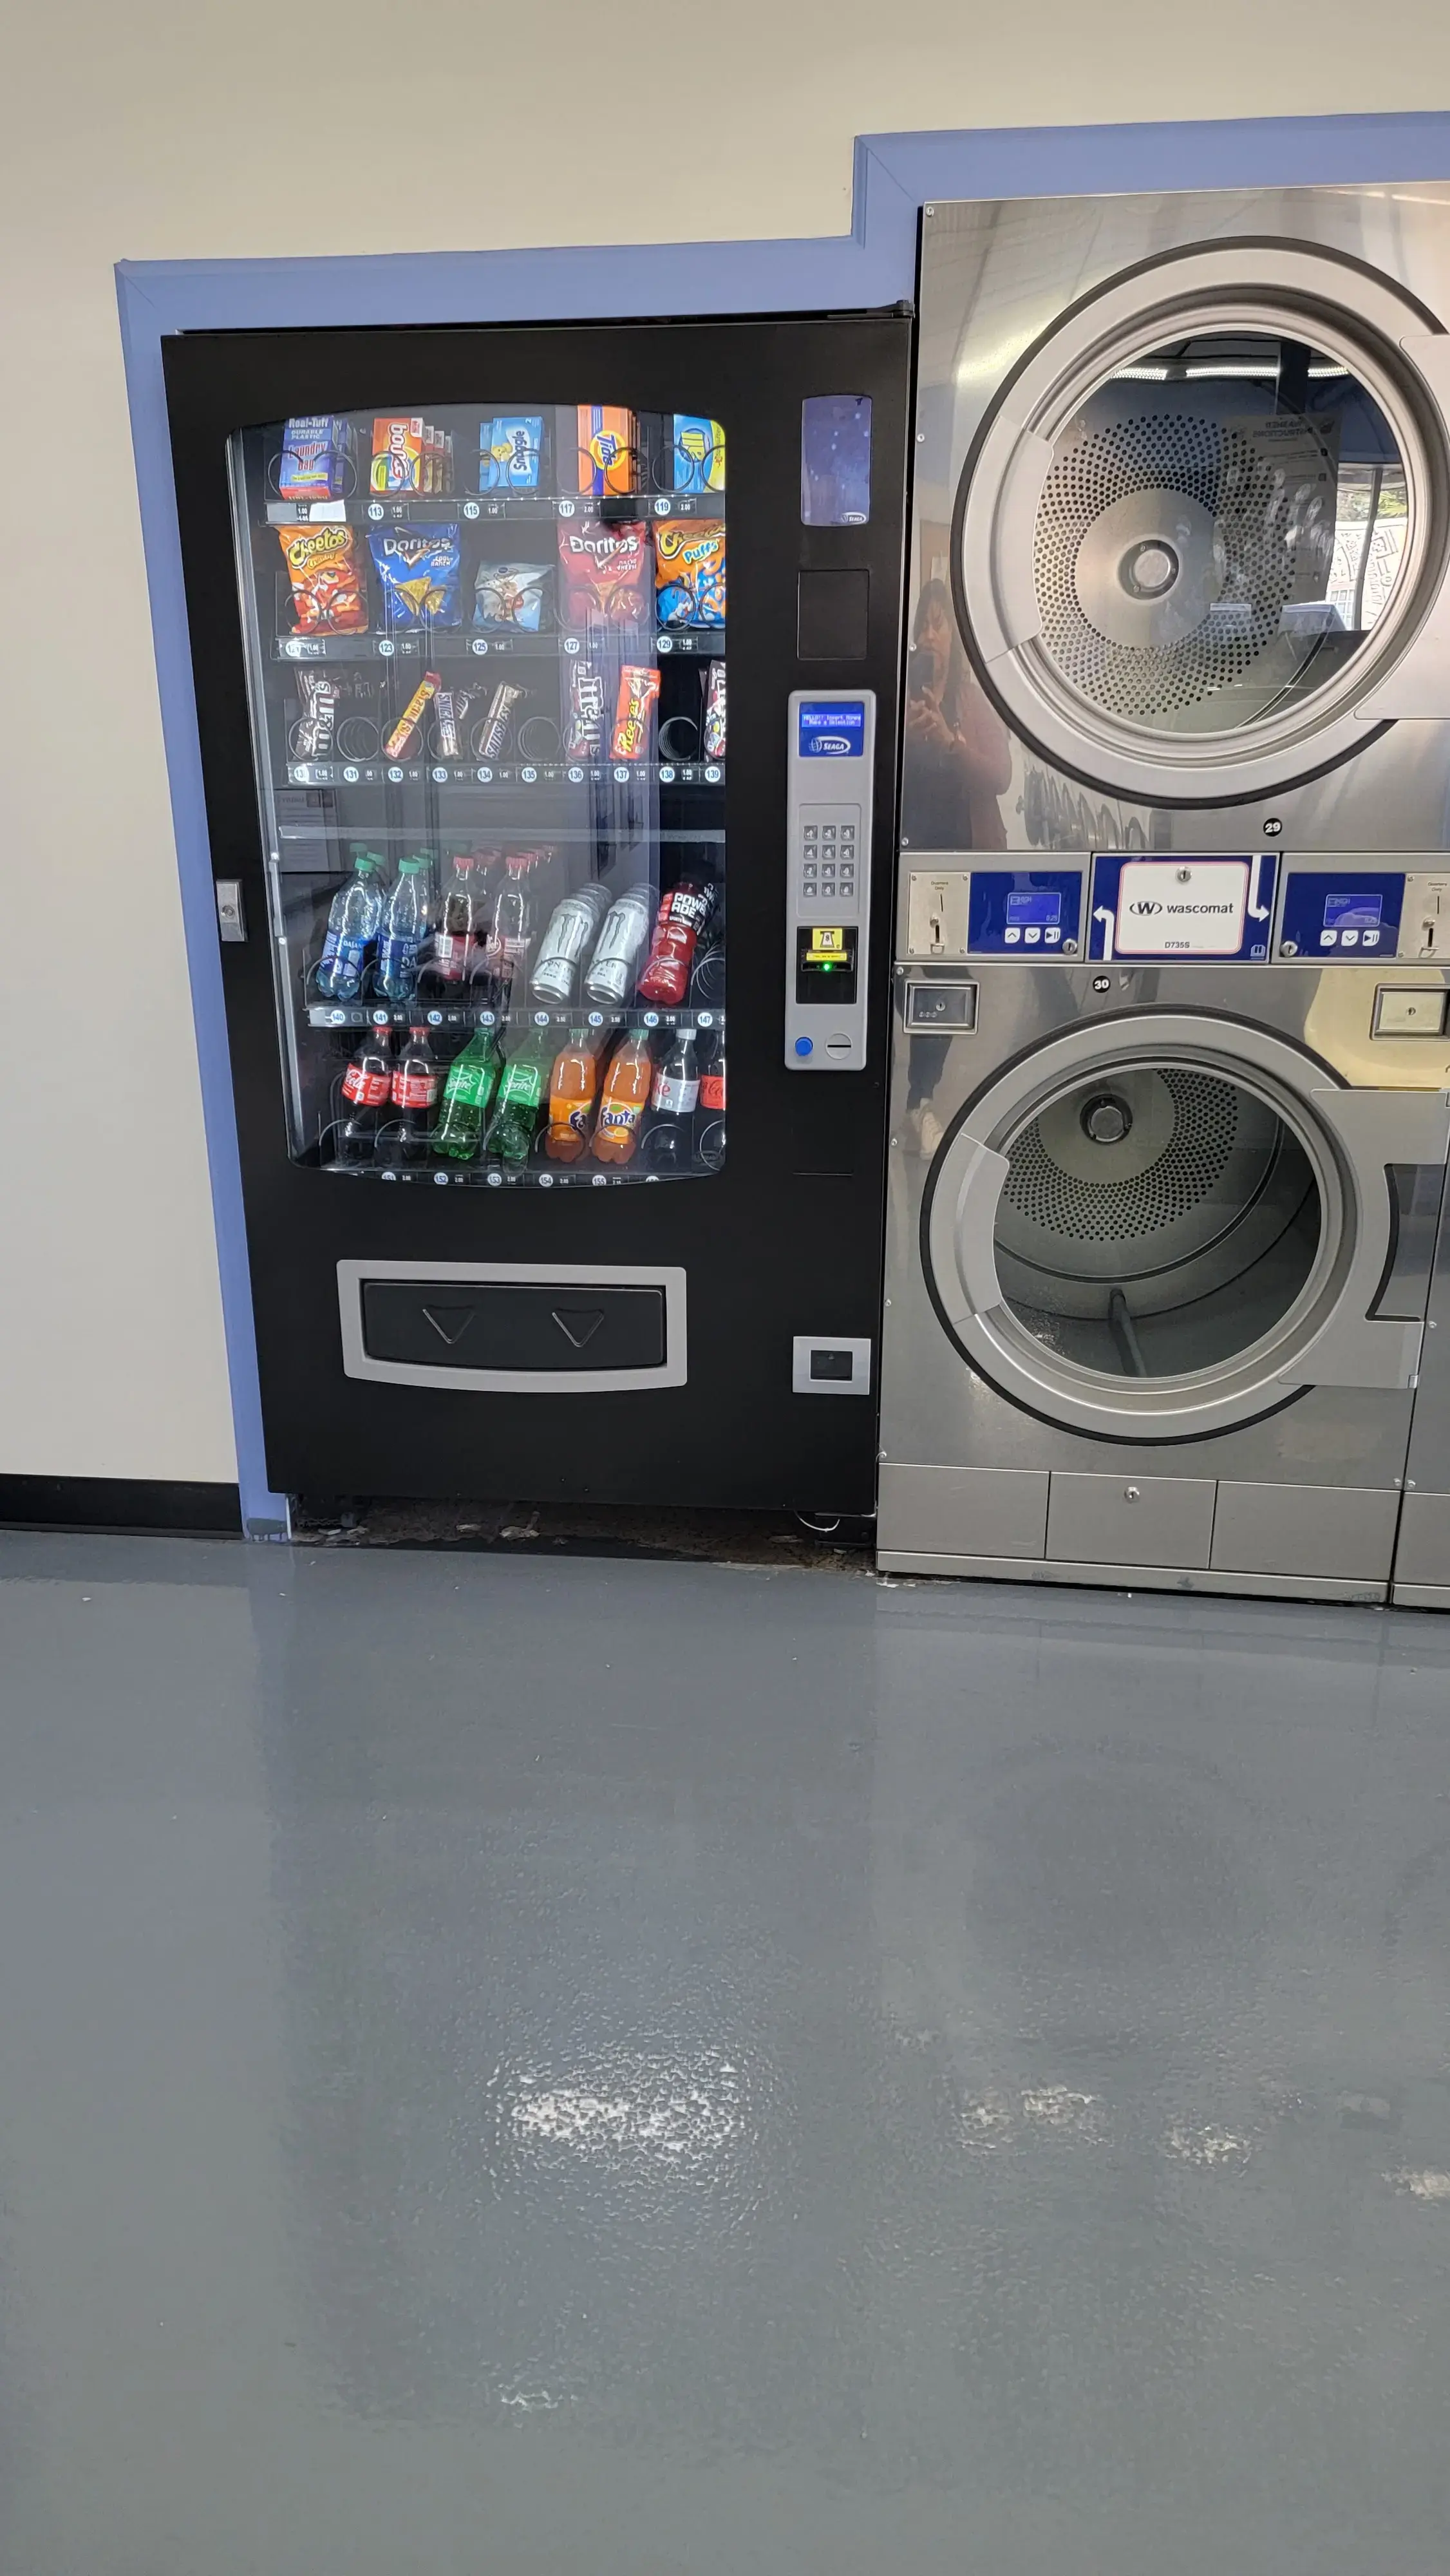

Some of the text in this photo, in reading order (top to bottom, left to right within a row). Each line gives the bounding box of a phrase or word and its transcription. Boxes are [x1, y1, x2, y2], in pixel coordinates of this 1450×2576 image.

[596, 433, 617, 468] Tide
[370, 507, 382, 516] 113
[465, 506, 478, 515] 115
[560, 504, 573, 514] 117
[655, 502, 669, 512] 119
[289, 527, 347, 565] Cheetos
[384, 538, 451, 556] Doritos
[569, 536, 638, 553] Doritos
[683, 539, 719, 564] Puffs
[380, 644, 393, 652] 123
[474, 643, 486, 651] 125
[566, 641, 578, 650] 127
[658, 640, 670, 649] 129
[823, 742, 845, 750] SEAGA
[345, 770, 357, 779] 131
[390, 770, 402, 779] 132
[434, 770, 446, 779] 133
[523, 770, 535, 779] 135
[570, 770, 582, 779] 136
[616, 770, 627, 779] 137
[661, 770, 673, 779] 138
[706, 770, 719, 779] 139
[1265, 822, 1281, 833] 29
[672, 902, 696, 918] ADE
[1167, 903, 1234, 914] wascomat
[1095, 978, 1109, 989] 30
[332, 1013, 343, 1021] 140
[375, 1013, 387, 1021] 141
[429, 1014, 440, 1022] 142
[482, 1014, 493, 1023] 143
[536, 1015, 547, 1023] 144
[590, 1015, 601, 1023] 145
[646, 1015, 657, 1023] 146
[700, 1015, 711, 1023] 147
[601, 1106, 636, 1128] Fanta
[541, 1176, 552, 1184] 154
